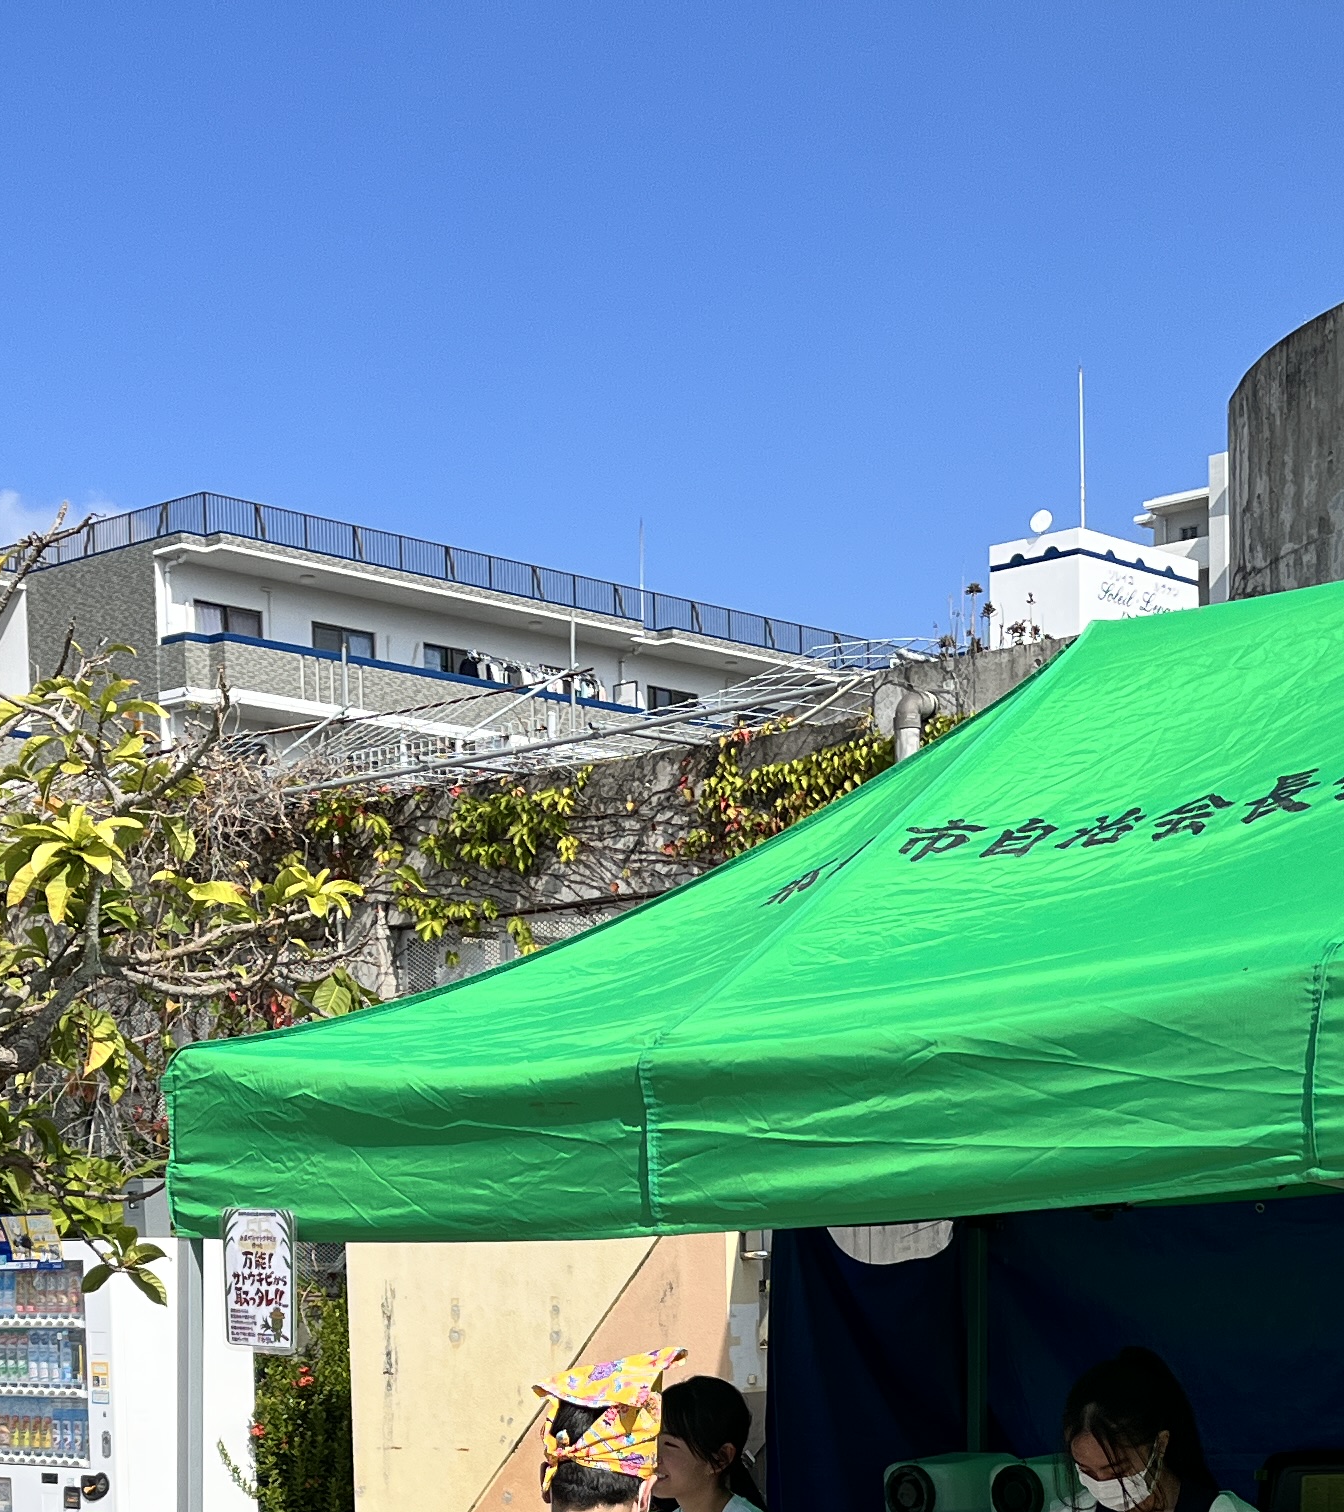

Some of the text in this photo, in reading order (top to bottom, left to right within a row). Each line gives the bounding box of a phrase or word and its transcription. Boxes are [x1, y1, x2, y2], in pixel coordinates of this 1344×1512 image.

[232, 1271, 288, 1287] サトウキビから
